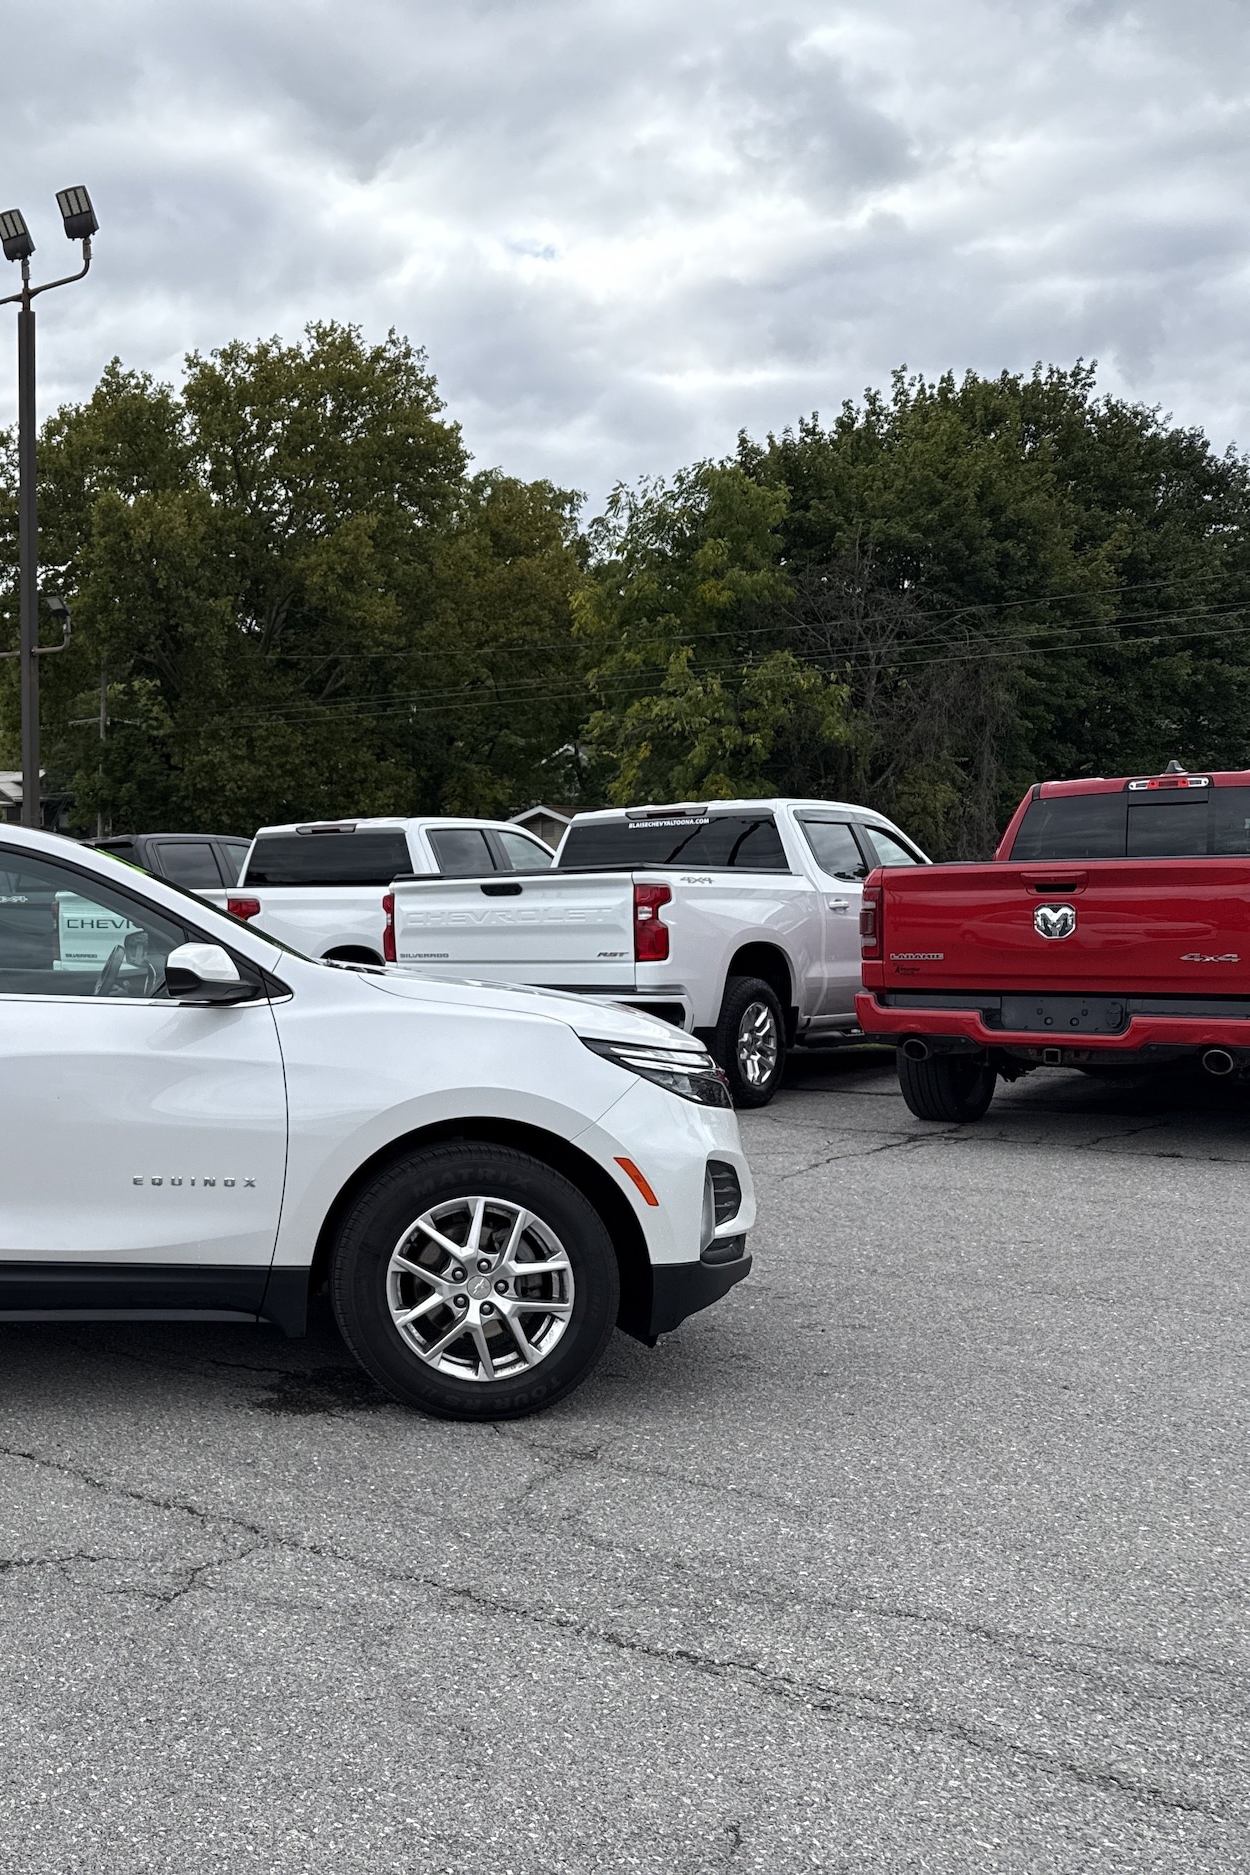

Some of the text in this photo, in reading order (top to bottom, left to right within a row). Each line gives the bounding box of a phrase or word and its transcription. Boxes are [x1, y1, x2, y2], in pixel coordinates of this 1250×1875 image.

[629, 818, 710, 828] BLAISECHEVYALTOONA.COM
[406, 907, 613, 925] CHEVROLET
[890, 952, 944, 960] LARAMIE
[133, 1175, 256, 1188] EQUINOX
